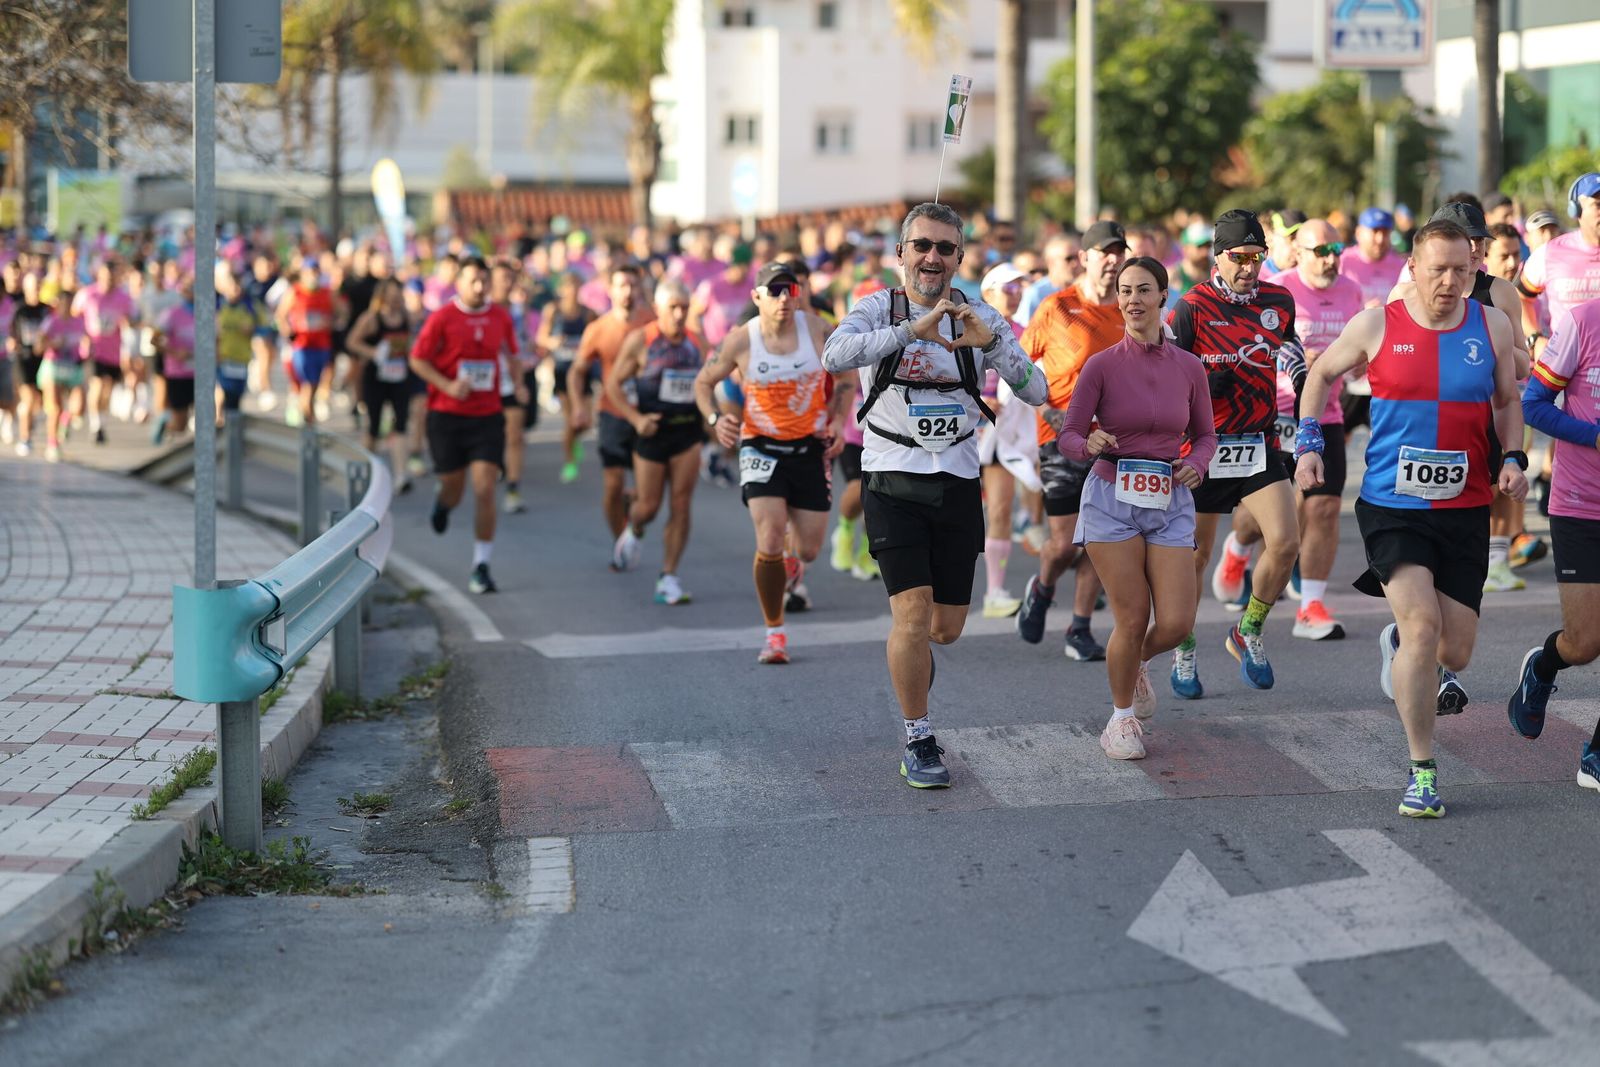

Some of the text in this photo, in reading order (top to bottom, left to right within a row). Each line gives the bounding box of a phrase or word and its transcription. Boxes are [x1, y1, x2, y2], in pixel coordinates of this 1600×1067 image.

[1393, 344, 1415, 353] 1895
[1200, 353, 1238, 364] INGENIO
[918, 417, 959, 437] 924
[1219, 445, 1256, 463] 277
[1403, 462, 1465, 485] 1083
[1120, 473, 1171, 497] 1893
